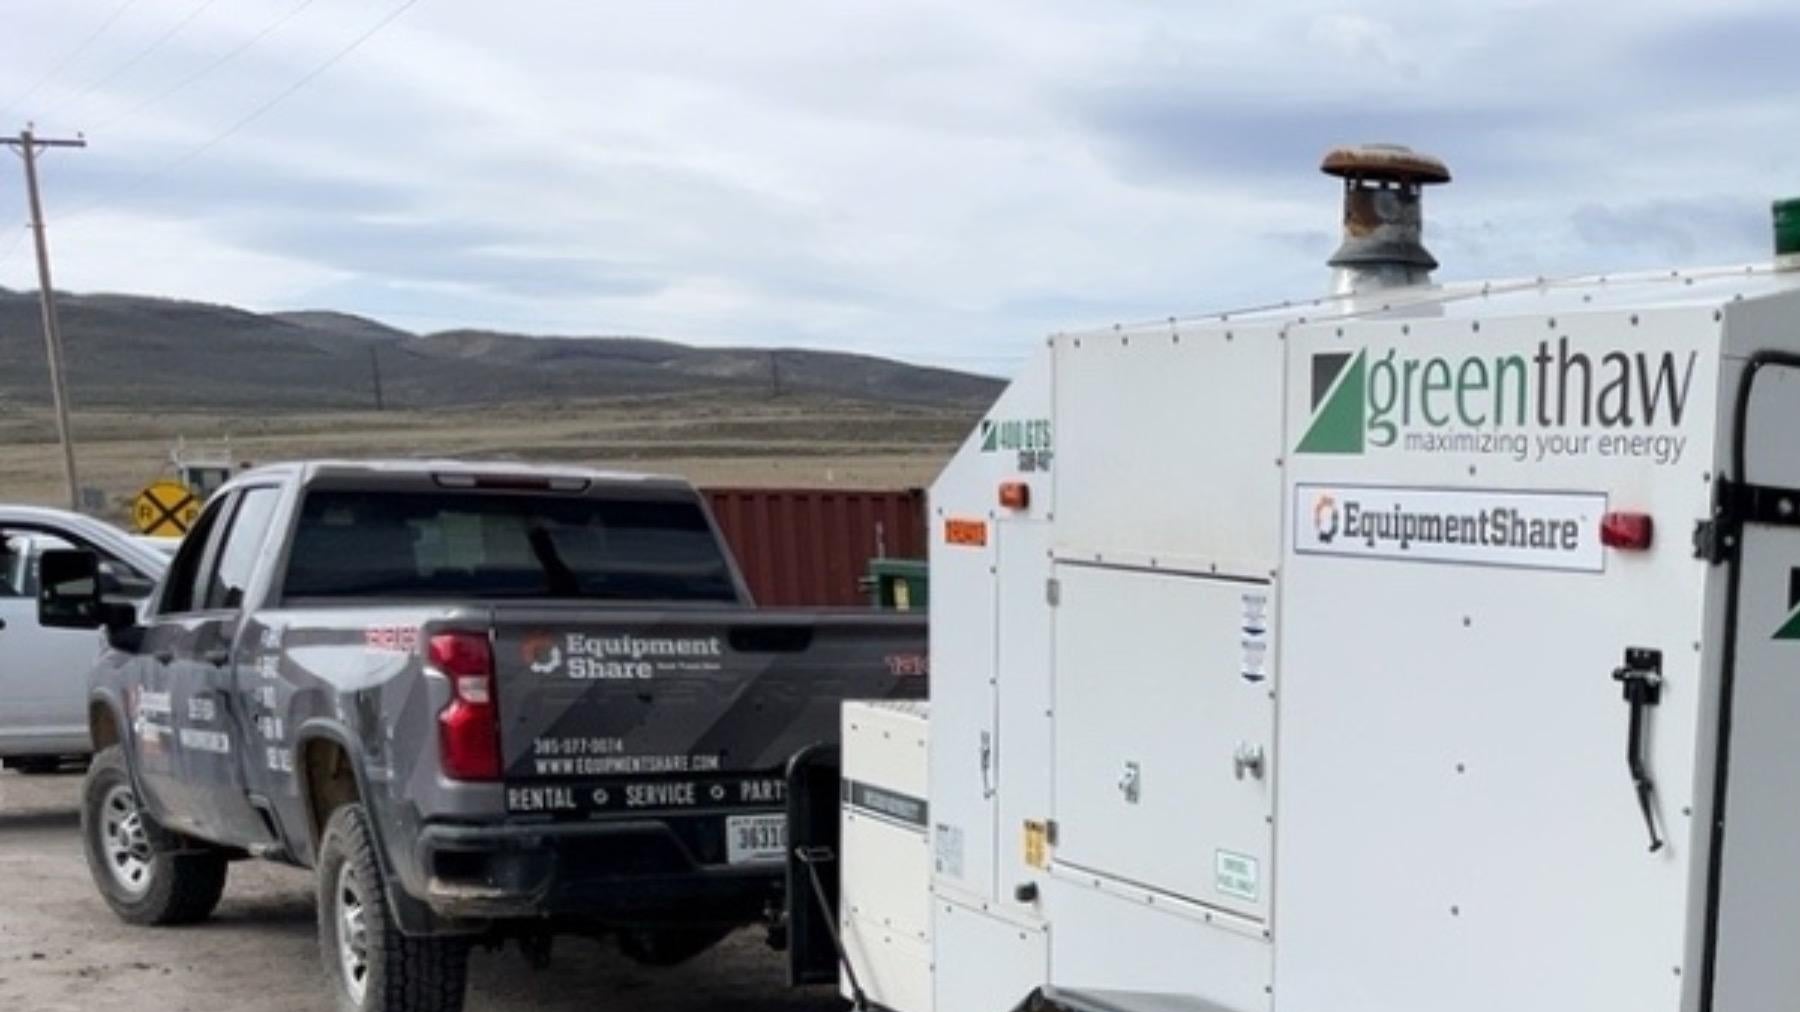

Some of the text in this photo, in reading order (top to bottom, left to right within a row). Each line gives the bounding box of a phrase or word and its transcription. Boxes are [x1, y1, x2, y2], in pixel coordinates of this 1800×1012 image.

[1367, 335, 1697, 448] greenthaw
[1404, 427, 1688, 466] maximizing your energy
[564, 632, 721, 658] Equipment
[567, 657, 653, 679] Share
[507, 778, 788, 811] RENTAL SERVICE PART
